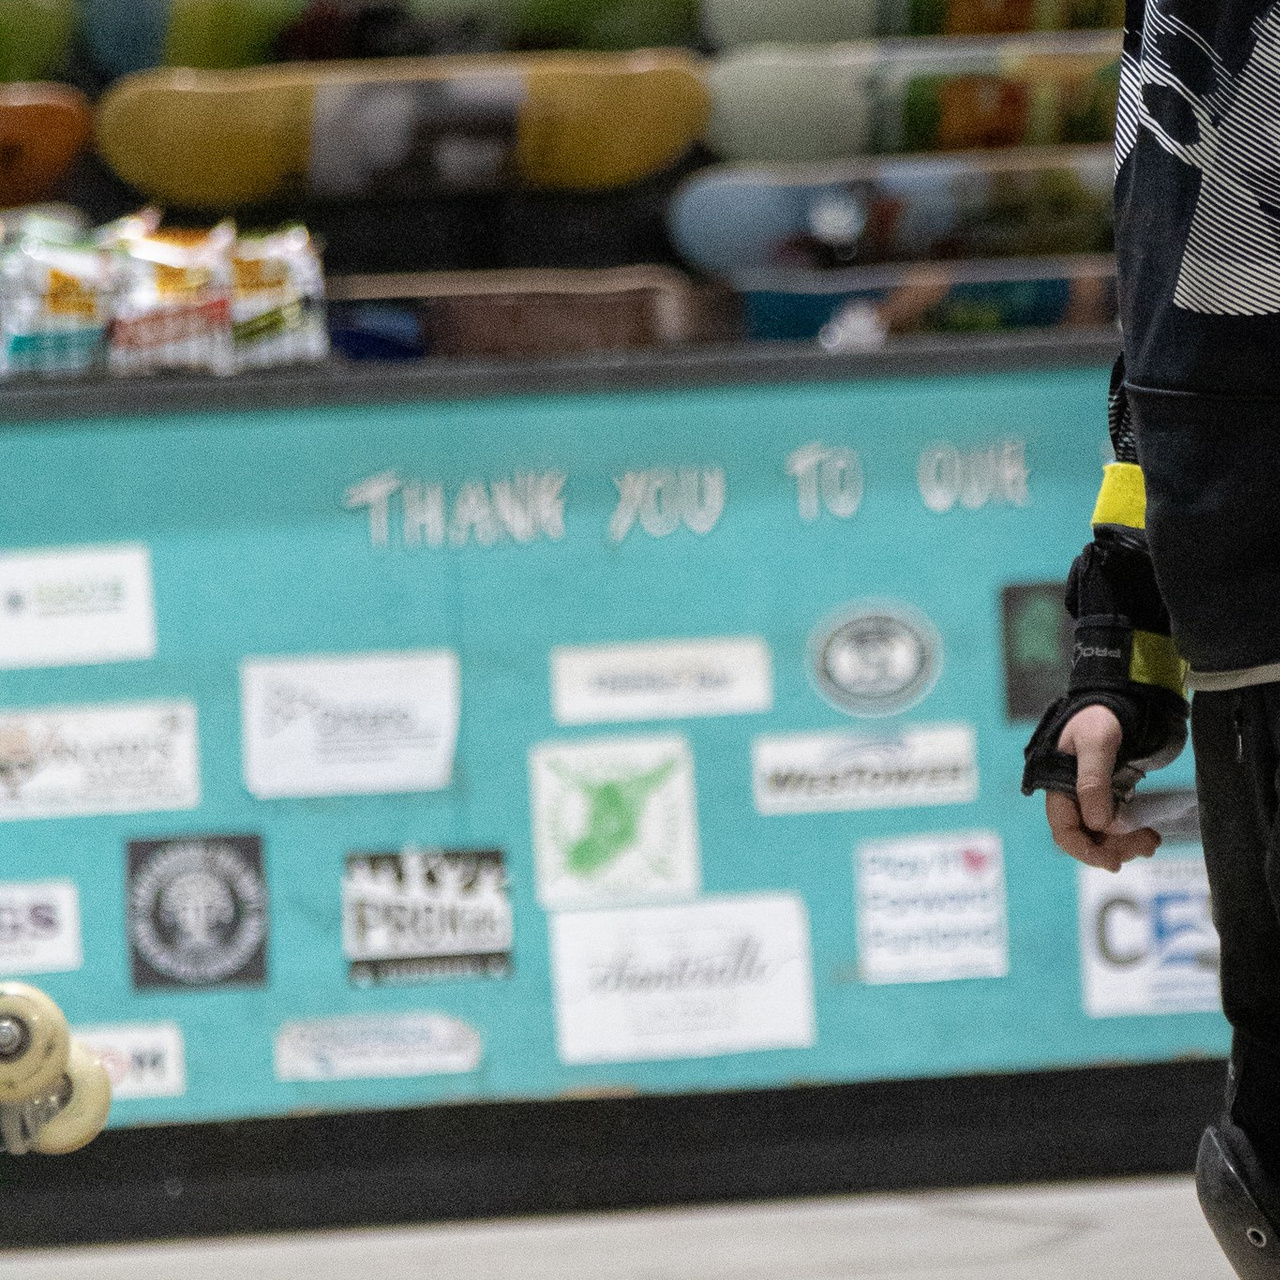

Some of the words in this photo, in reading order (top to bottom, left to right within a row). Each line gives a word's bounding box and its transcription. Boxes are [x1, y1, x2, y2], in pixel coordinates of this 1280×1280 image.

[346, 469, 567, 547] THANK
[610, 467, 725, 540] YOU
[786, 440, 864, 518] TO
[918, 436, 1031, 514] OUR
